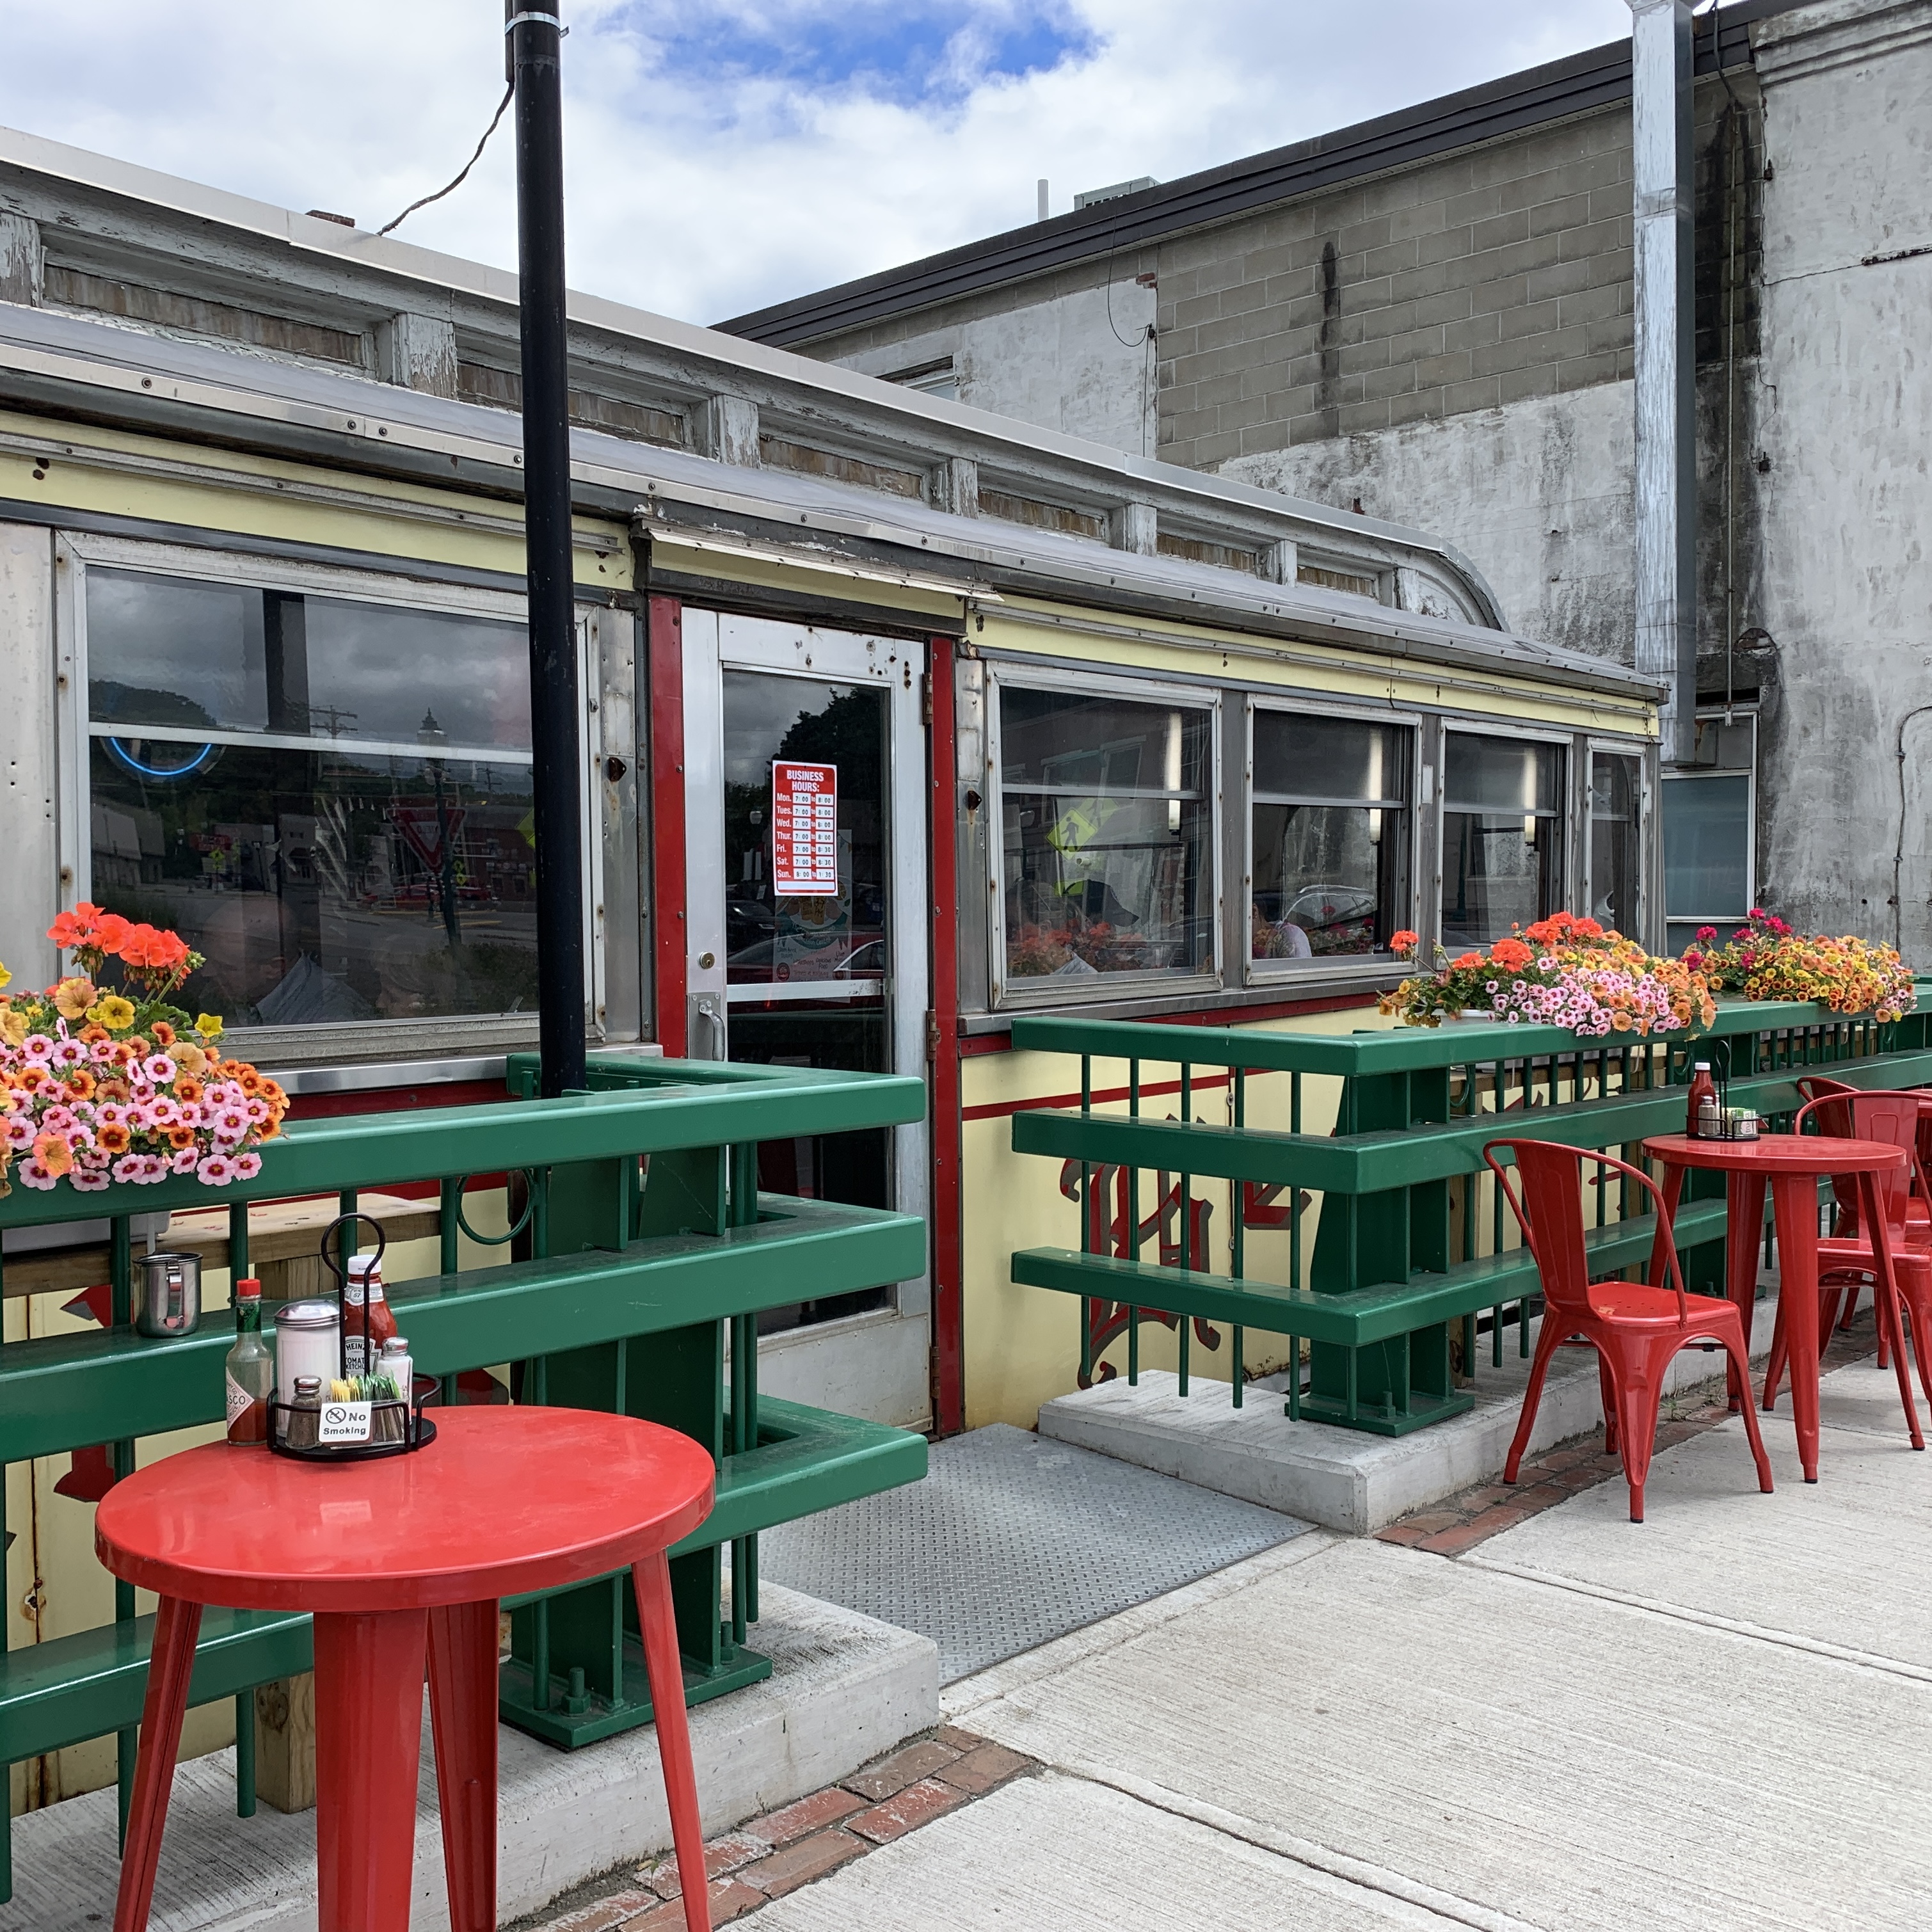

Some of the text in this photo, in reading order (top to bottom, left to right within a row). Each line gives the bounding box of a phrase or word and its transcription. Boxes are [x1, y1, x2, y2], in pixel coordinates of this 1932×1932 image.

[786, 770, 824, 782] BUSINESS
[792, 781, 819, 792] HOURS:
[777, 793, 792, 802] Mon.
[777, 806, 792, 814] Tues.
[777, 818, 791, 827] Wed.
[777, 831, 792, 840] Thur.
[777, 844, 787, 852] Fri.
[777, 857, 789, 865] Sat.
[777, 869, 791, 878] Sun.
[349, 1412, 366, 1421] No
[323, 1427, 366, 1435] Smoking
